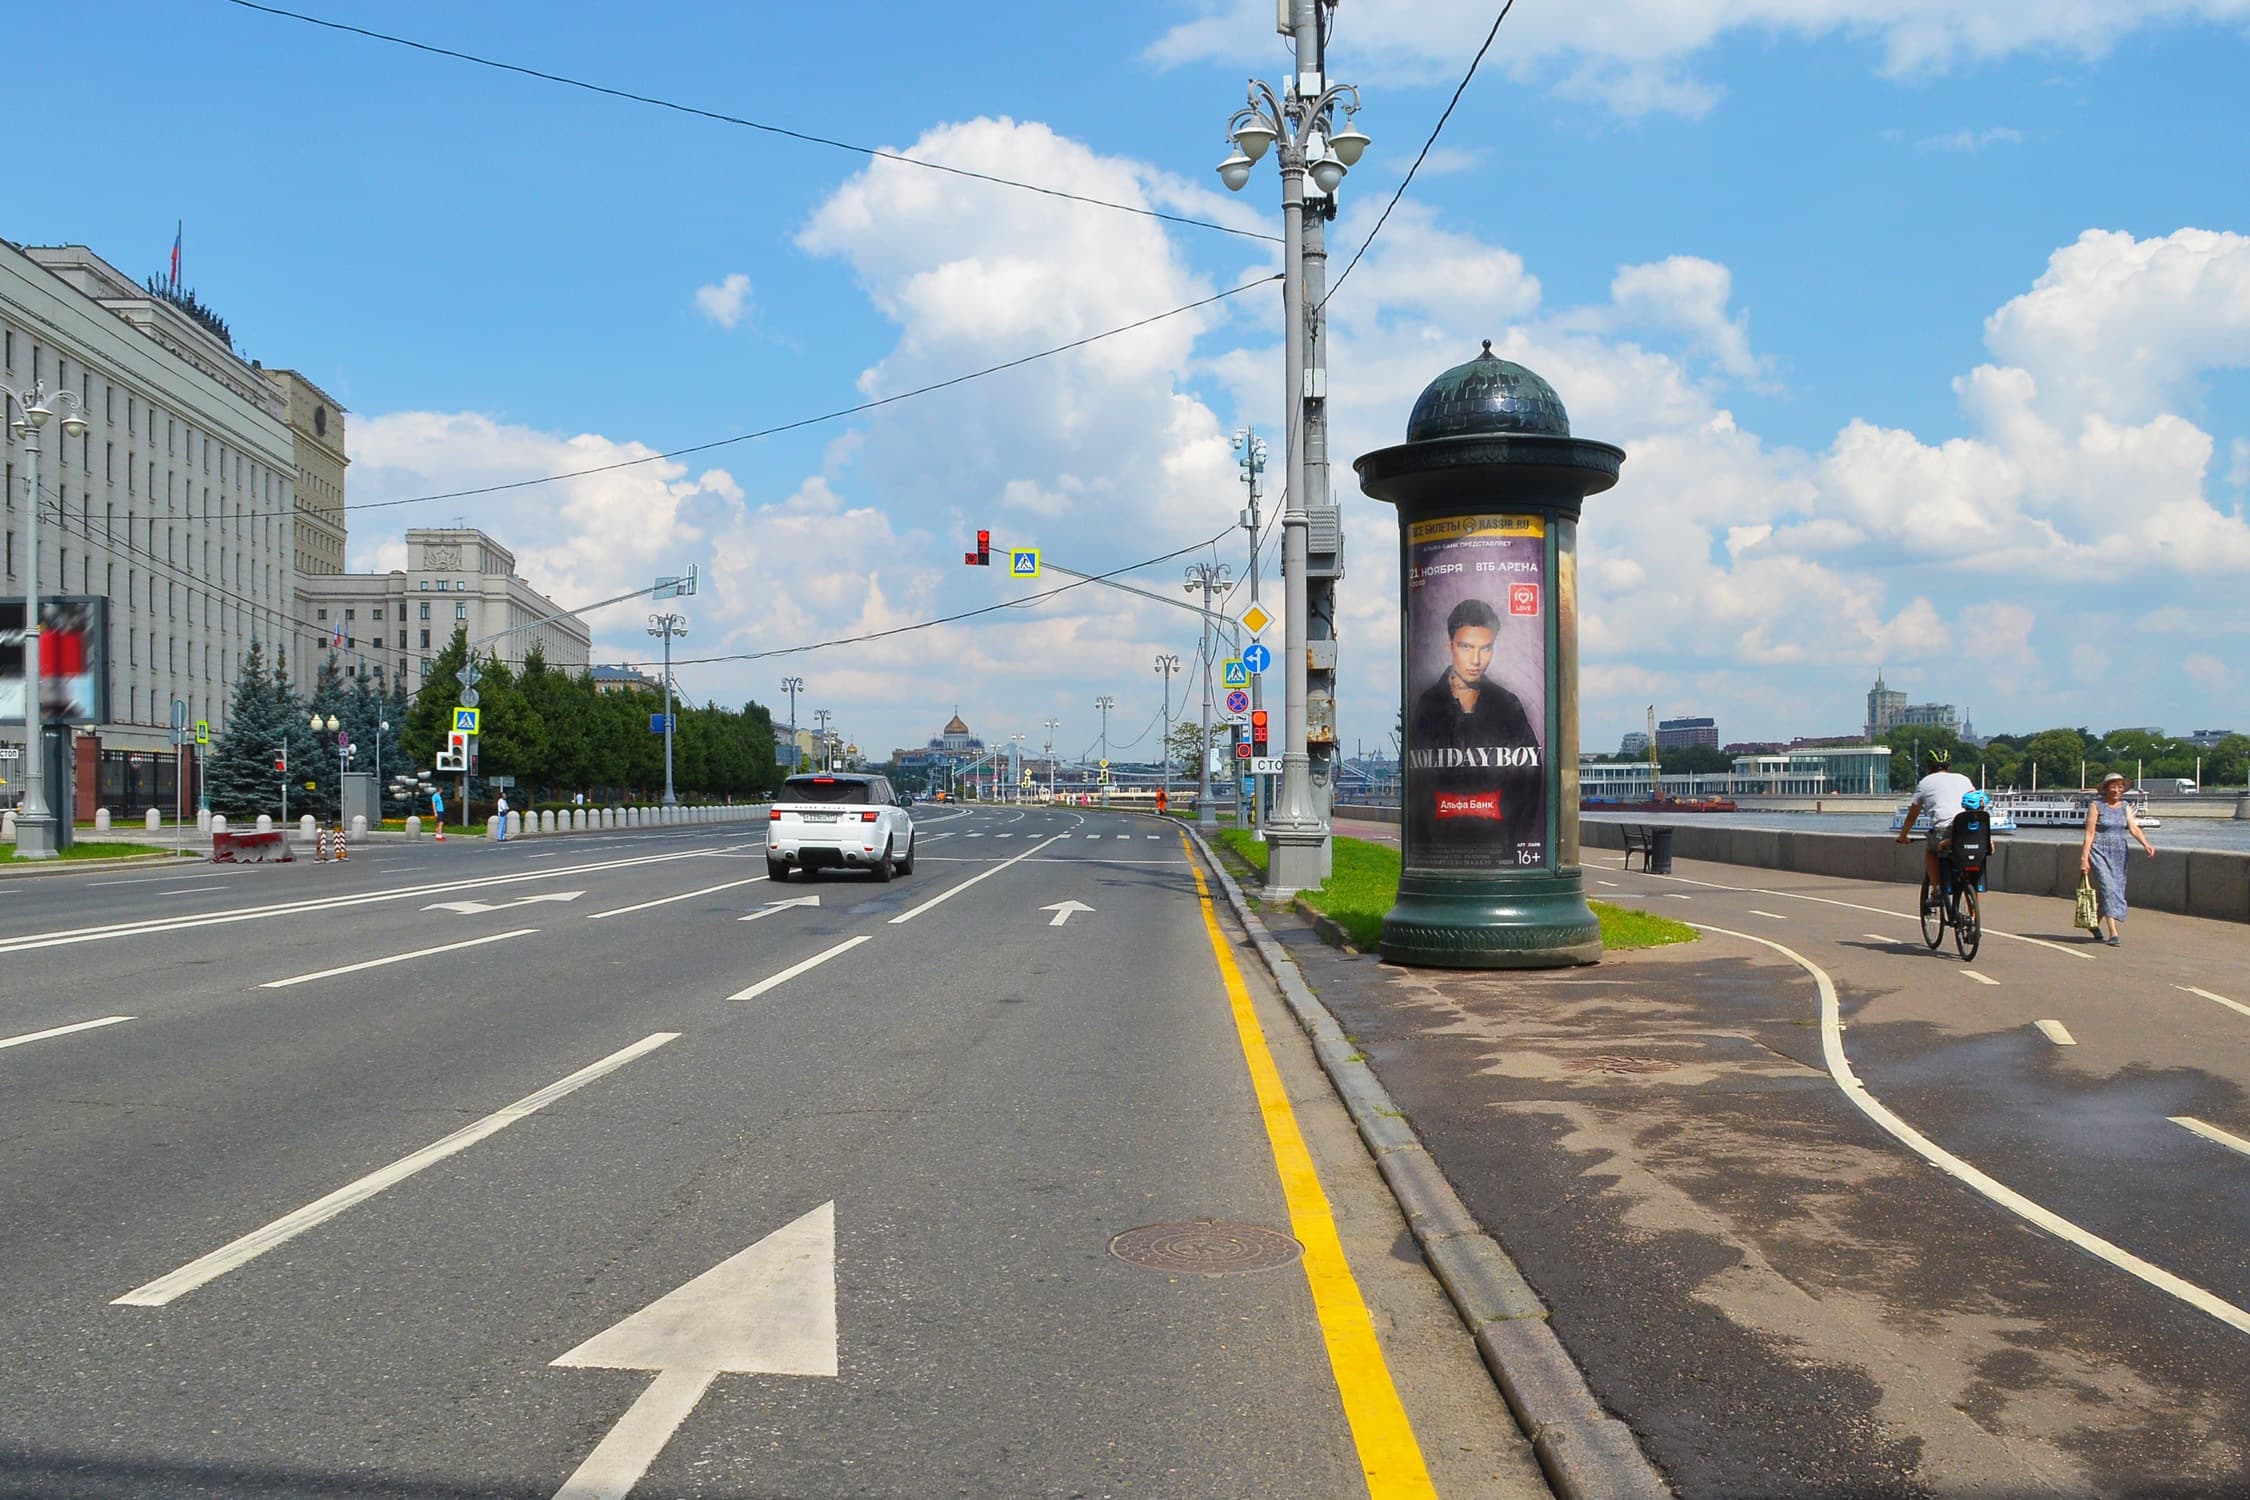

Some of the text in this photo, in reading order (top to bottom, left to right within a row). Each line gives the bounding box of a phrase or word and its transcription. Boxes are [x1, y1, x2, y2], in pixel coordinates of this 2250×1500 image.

[1425, 521, 1460, 535] БИЛЕТЫ
[1421, 563, 1463, 577] НОЯБРЯ
[1475, 562, 1538, 573] ВТБ АРЕНА
[1440, 799, 1494, 811] Альфа Банк
[1516, 850, 1541, 865] 16+
